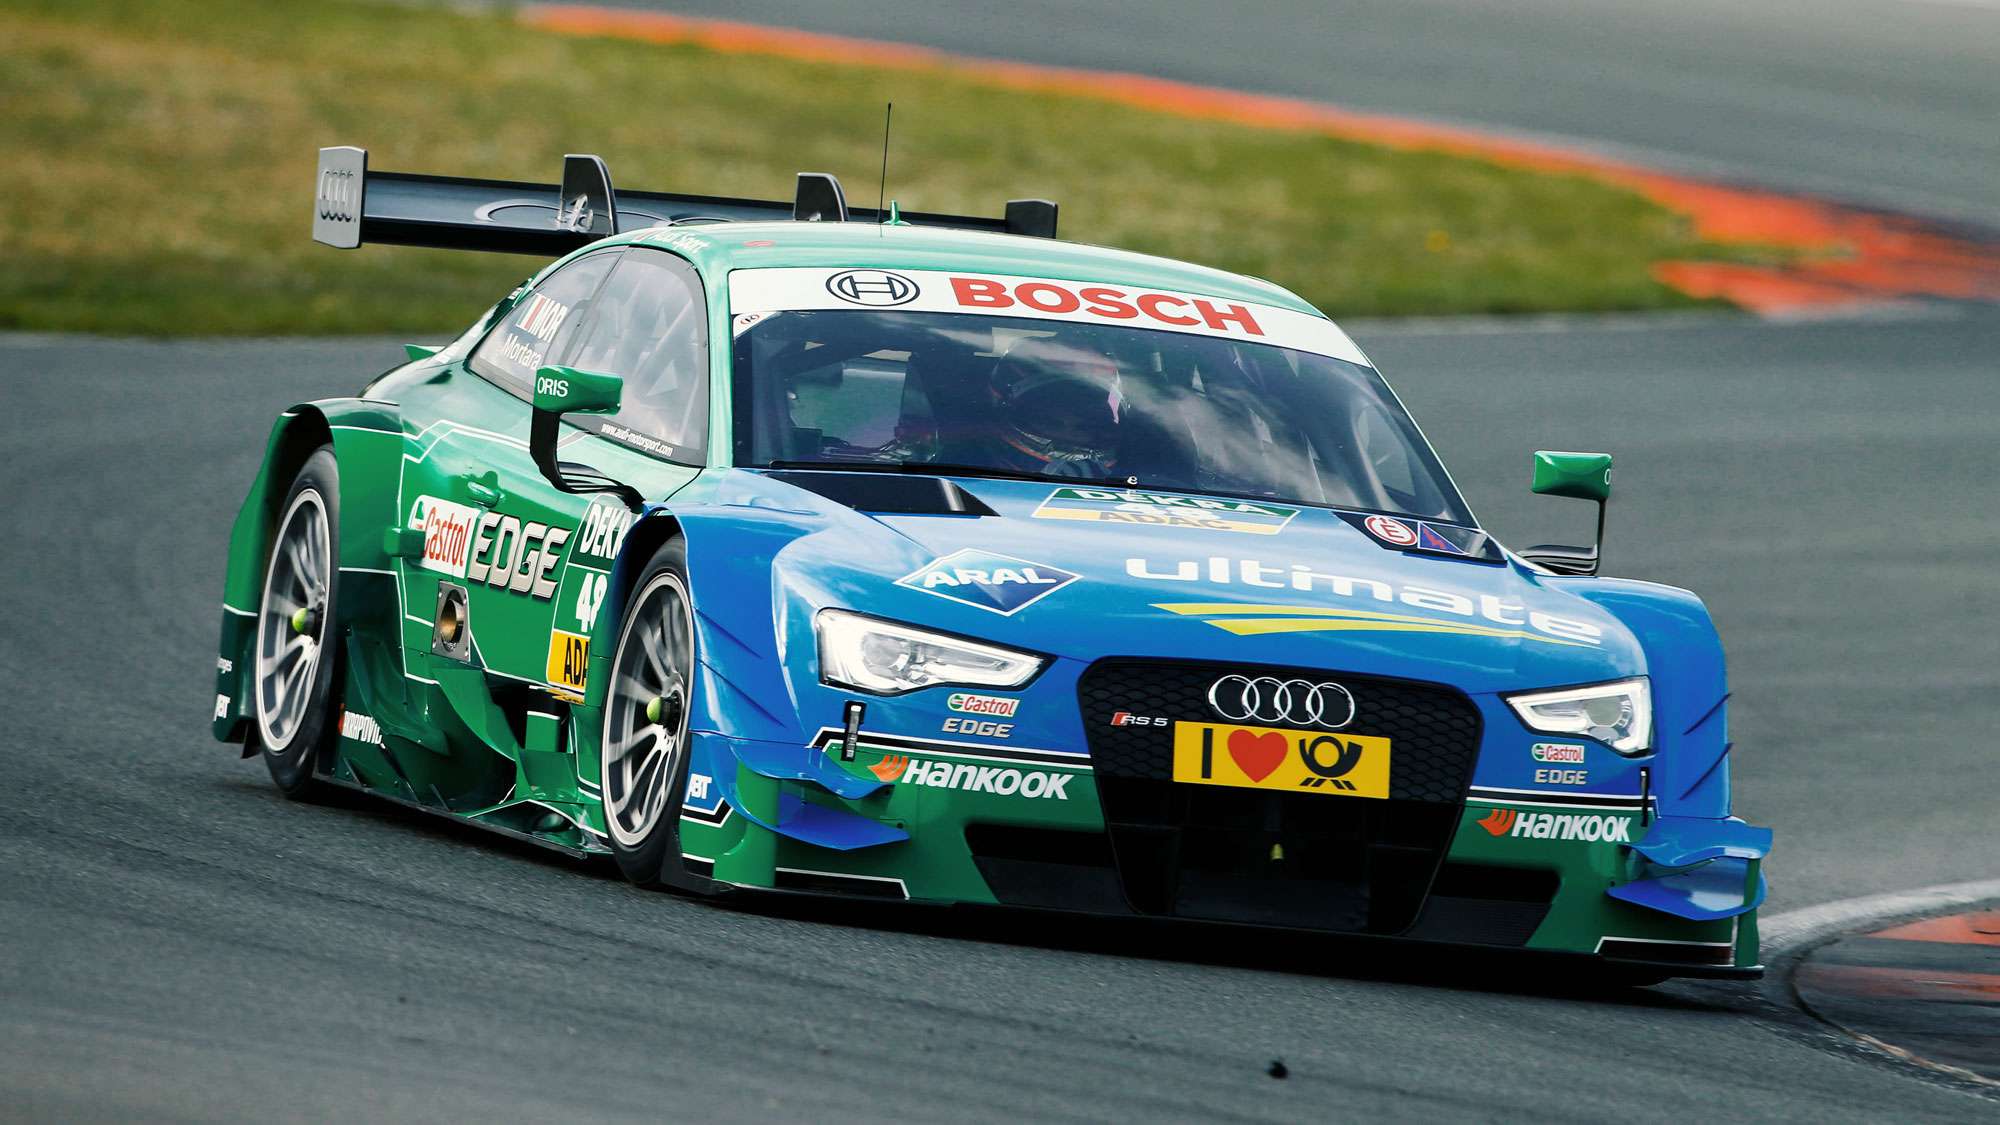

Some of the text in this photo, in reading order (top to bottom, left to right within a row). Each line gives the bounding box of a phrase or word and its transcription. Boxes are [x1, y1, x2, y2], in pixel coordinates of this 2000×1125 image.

[949, 277, 1266, 336] BOSCH
[503, 333, 541, 370] Mortara
[537, 376, 568, 397] ORIS
[601, 423, 673, 457] www.audi-motorsport.com
[1071, 489, 1281, 516] DEKRA
[579, 503, 633, 560] DEKR
[1098, 511, 1232, 529] ADAC
[423, 506, 573, 599] Castrol EDGE
[922, 567, 1057, 588] ARAL
[1126, 557, 1601, 645] ultimate
[564, 637, 590, 687] ADA
[964, 695, 1016, 716] Castrol
[941, 717, 1016, 738] EDGE
[1119, 714, 1168, 726] RS 5
[1201, 727, 1213, 779] I
[1546, 744, 1585, 762] Castrol
[1534, 768, 1589, 785] EDGE
